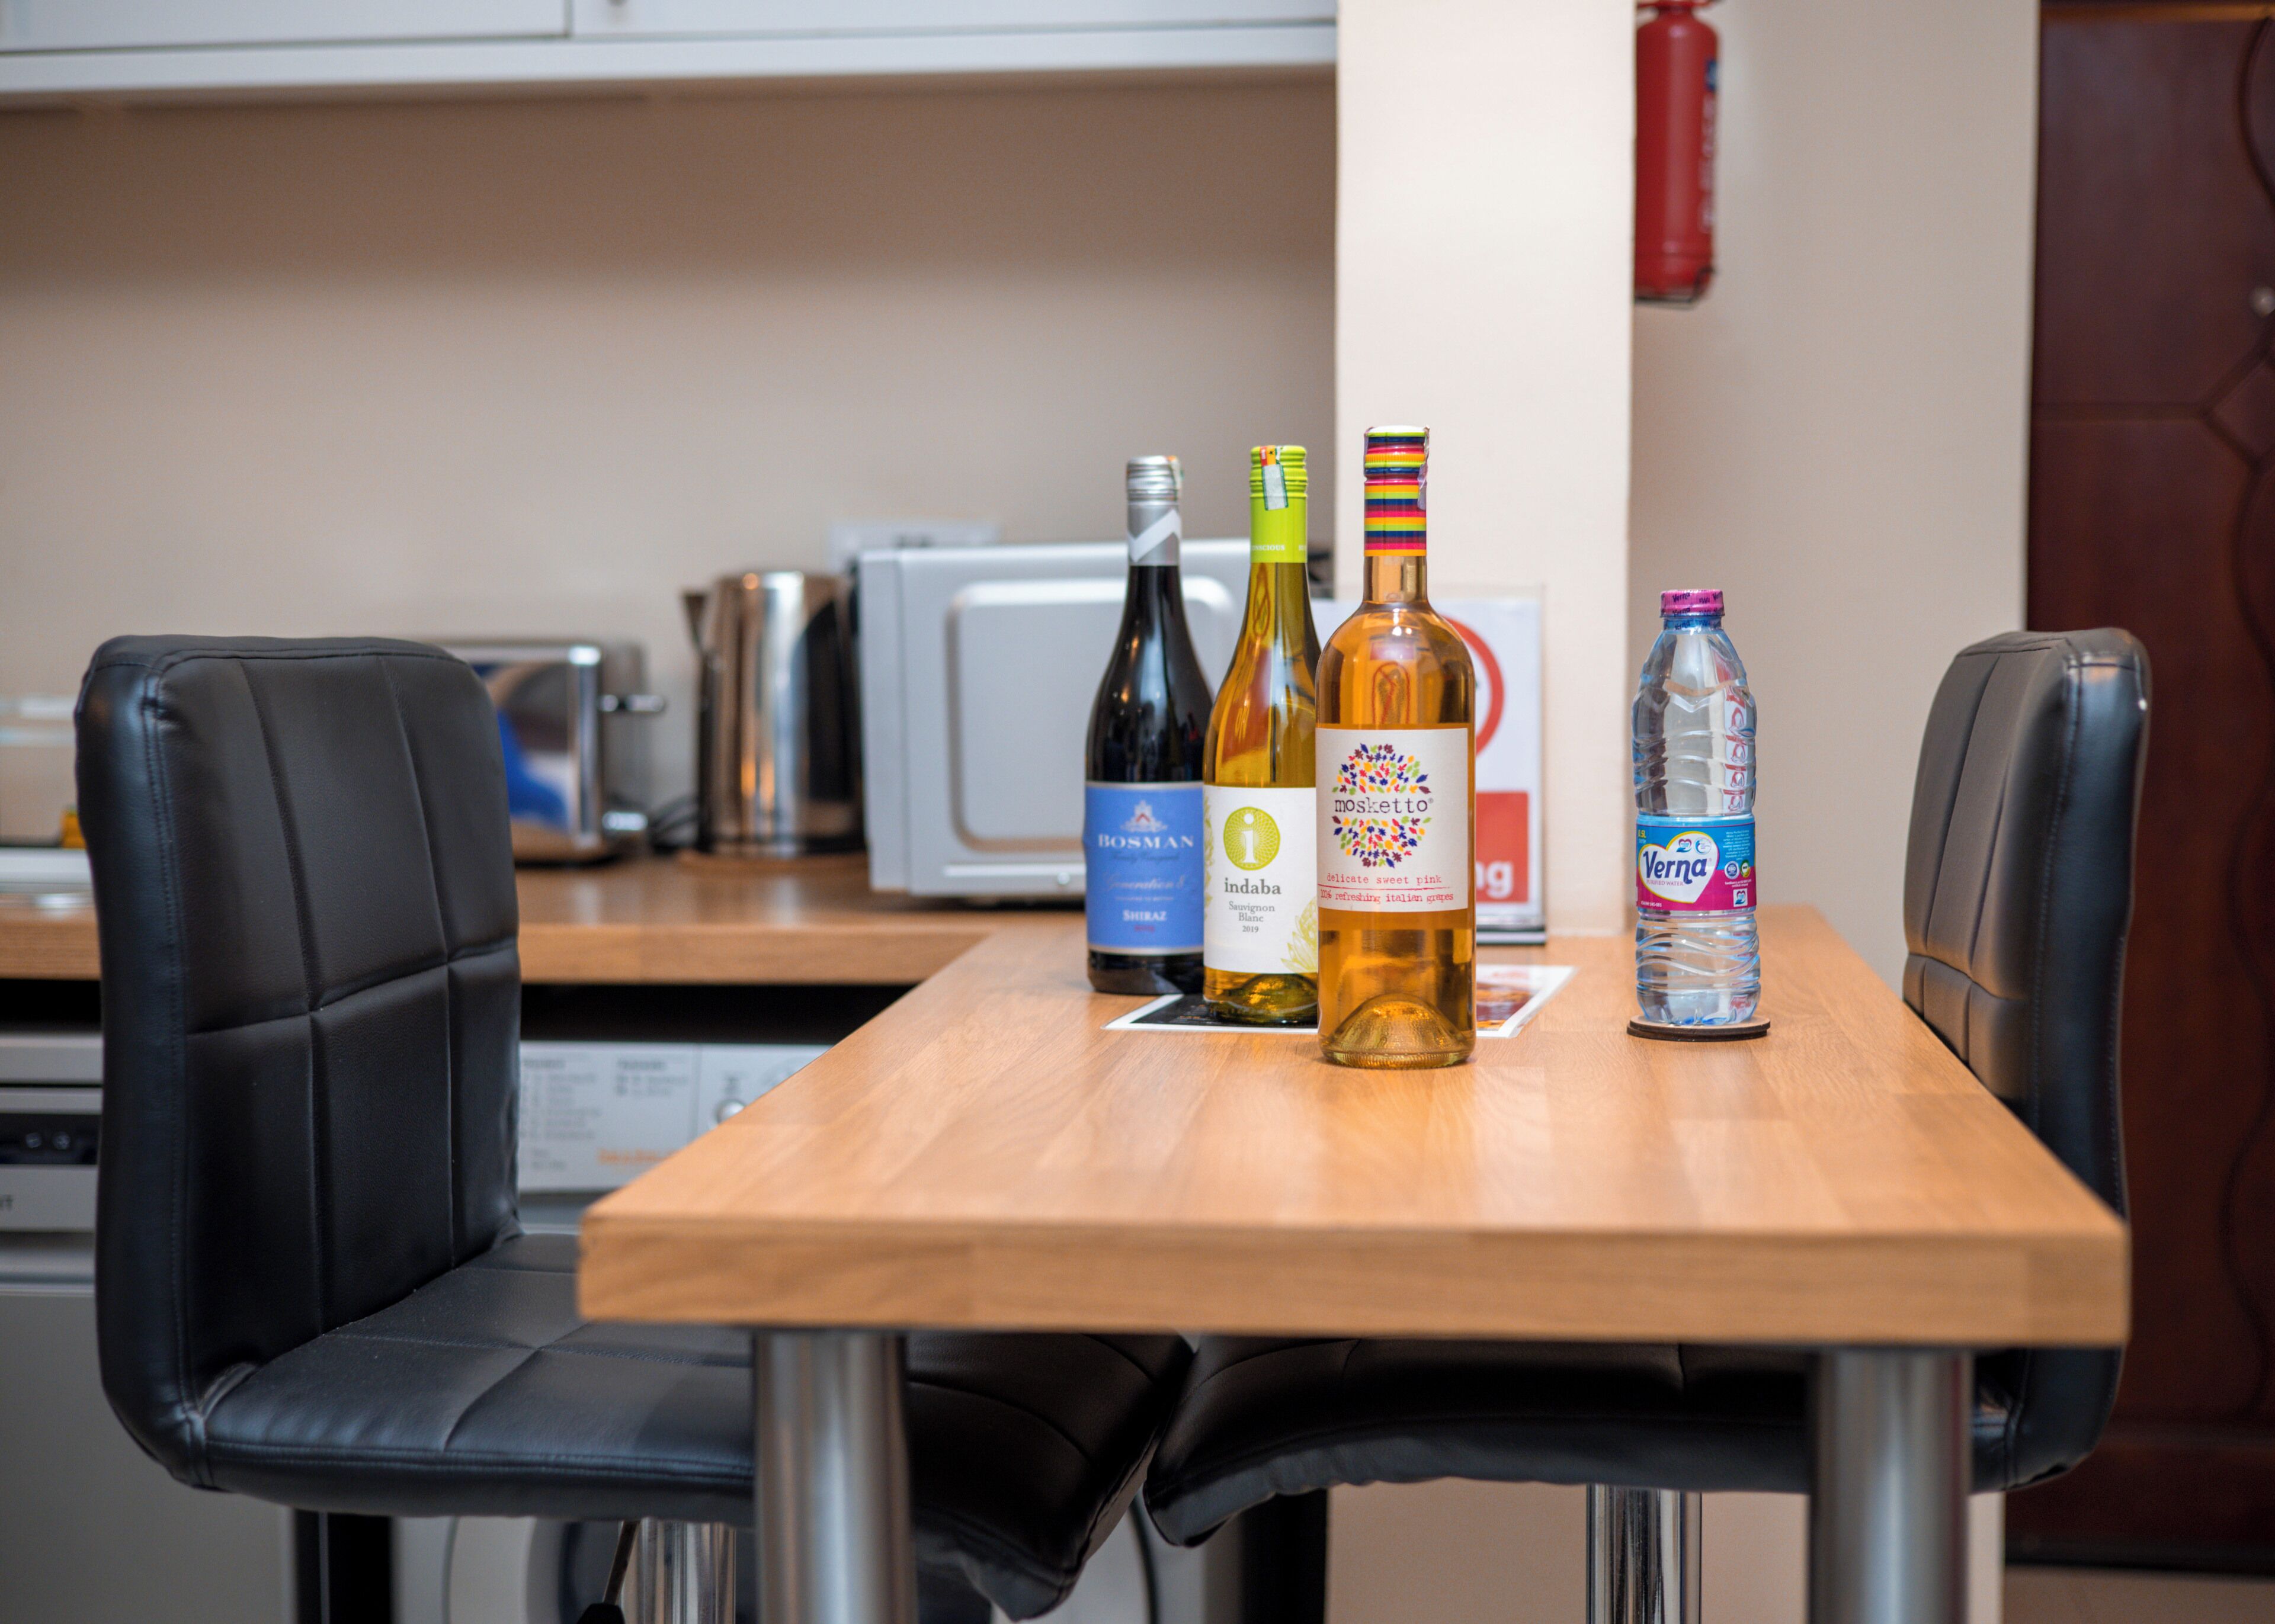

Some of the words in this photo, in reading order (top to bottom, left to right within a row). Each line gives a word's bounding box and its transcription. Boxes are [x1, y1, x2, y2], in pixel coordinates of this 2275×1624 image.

[1335, 797, 1428, 813] mosketto
[1098, 834, 1194, 849] BOSMAN
[1643, 850, 1707, 884] Verna
[1224, 877, 1282, 894] indaba
[1326, 873, 1369, 884] delicate
[1376, 875, 1409, 884] sweet
[1417, 875, 1441, 885] pink
[1321, 889, 1332, 900] 100%
[1335, 893, 1381, 904] refreshing
[1386, 894, 1422, 903] italian
[1427, 893, 1454, 904] grapes
[1229, 900, 1275, 914] Sauvignon
[1238, 912, 1264, 922] Blanc
